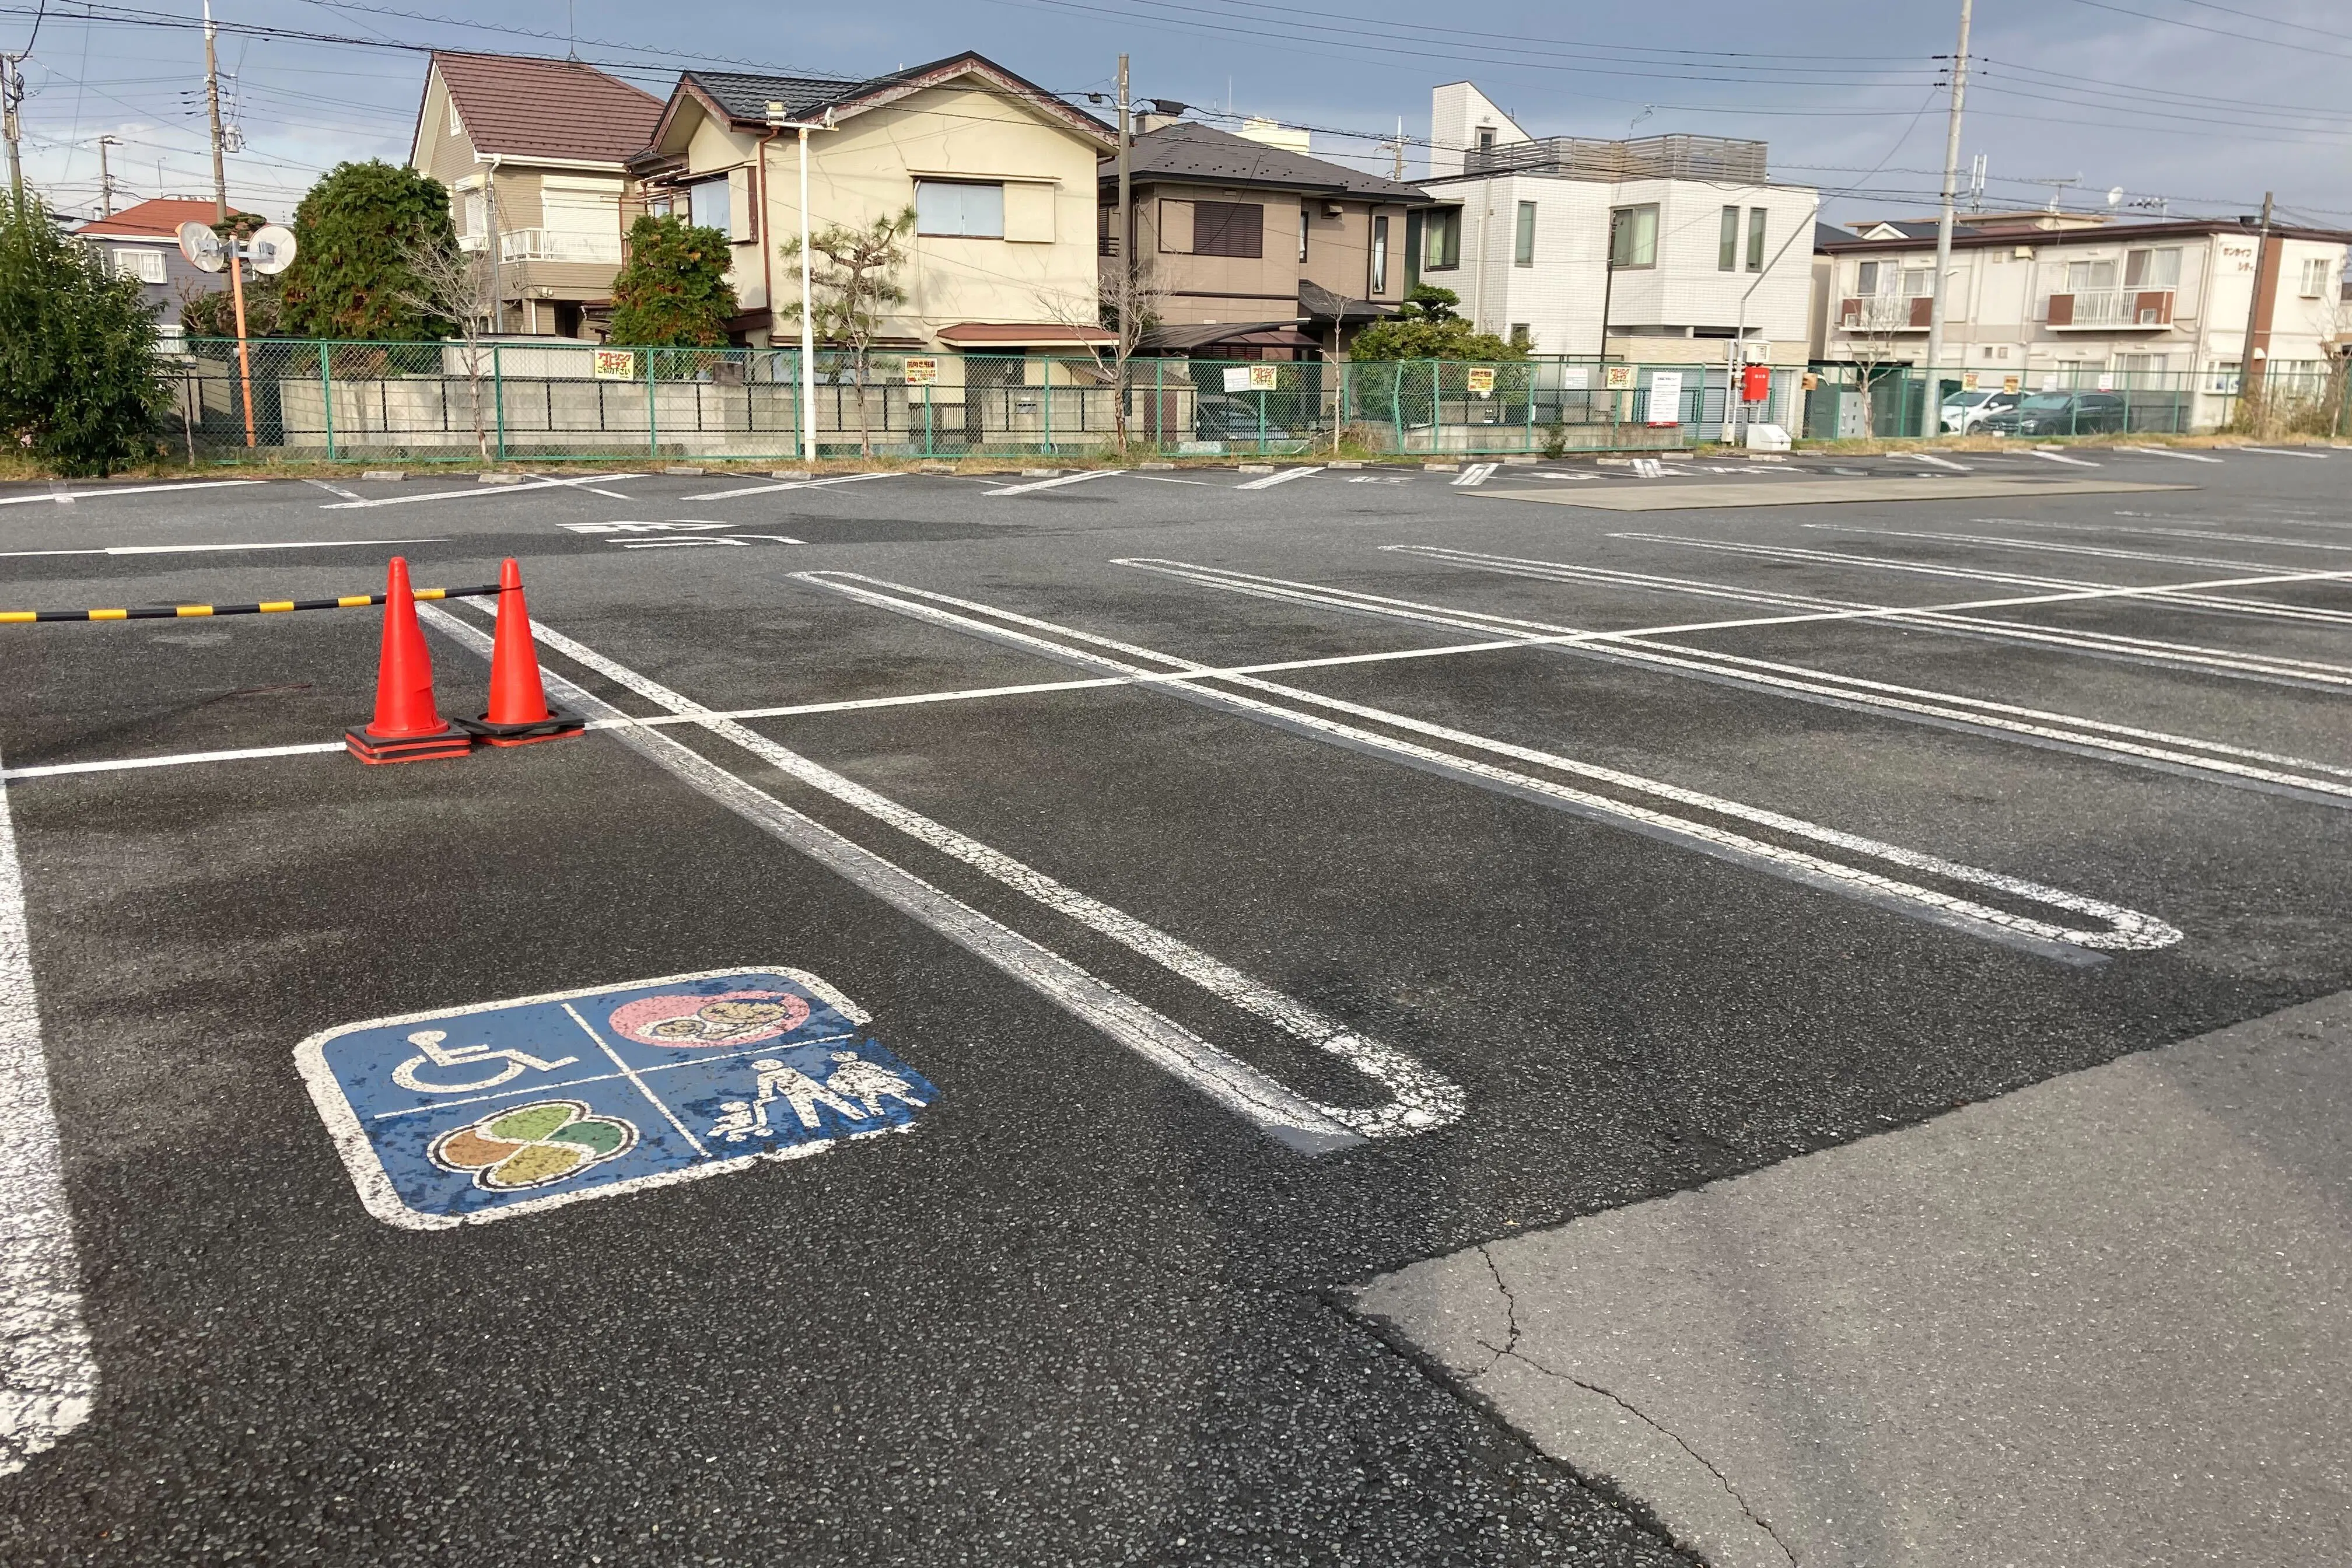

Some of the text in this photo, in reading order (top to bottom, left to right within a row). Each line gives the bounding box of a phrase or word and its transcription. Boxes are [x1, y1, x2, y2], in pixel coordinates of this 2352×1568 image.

[597, 352, 632, 362] アイドリング
[602, 359, 627, 369] ストップ
[598, 366, 630, 374] ご協力下さい
[555, 519, 809, 548] 徐行
